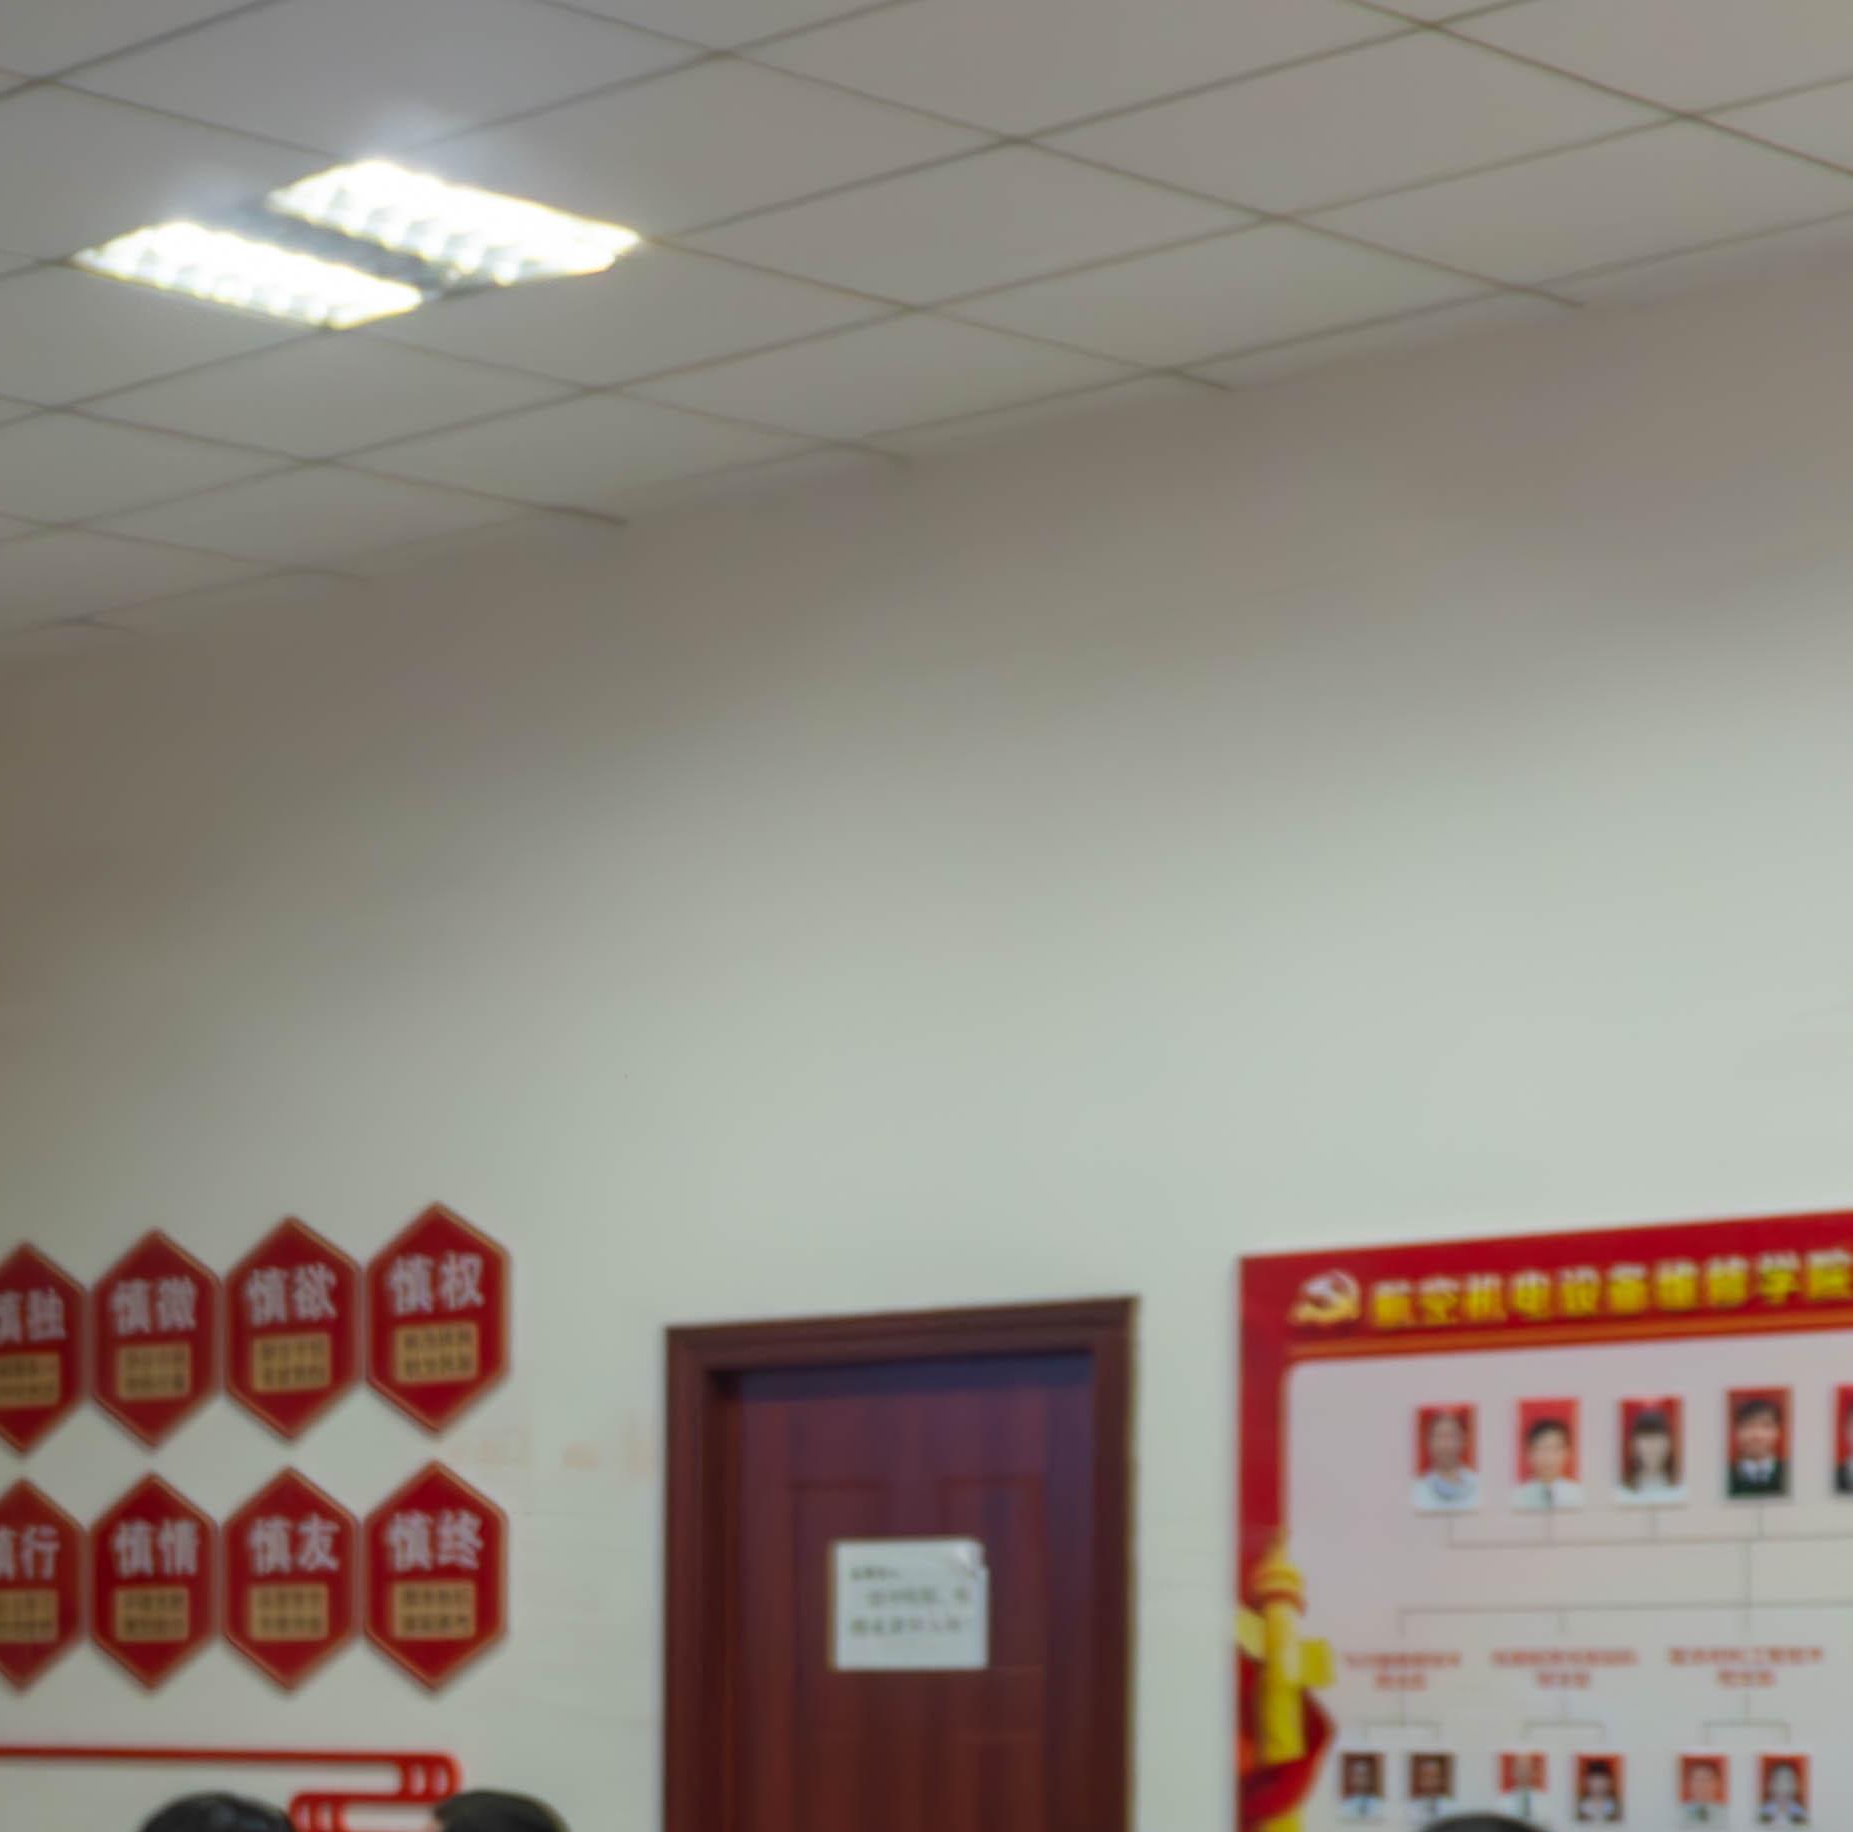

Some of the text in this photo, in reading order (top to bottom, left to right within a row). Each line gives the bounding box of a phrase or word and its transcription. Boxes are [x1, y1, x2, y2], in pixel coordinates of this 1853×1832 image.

[387, 1250, 484, 1317] 慎权
[113, 1516, 199, 1577] 慎情
[249, 1513, 341, 1576] 慎友
[386, 1509, 484, 1573] 慎终
